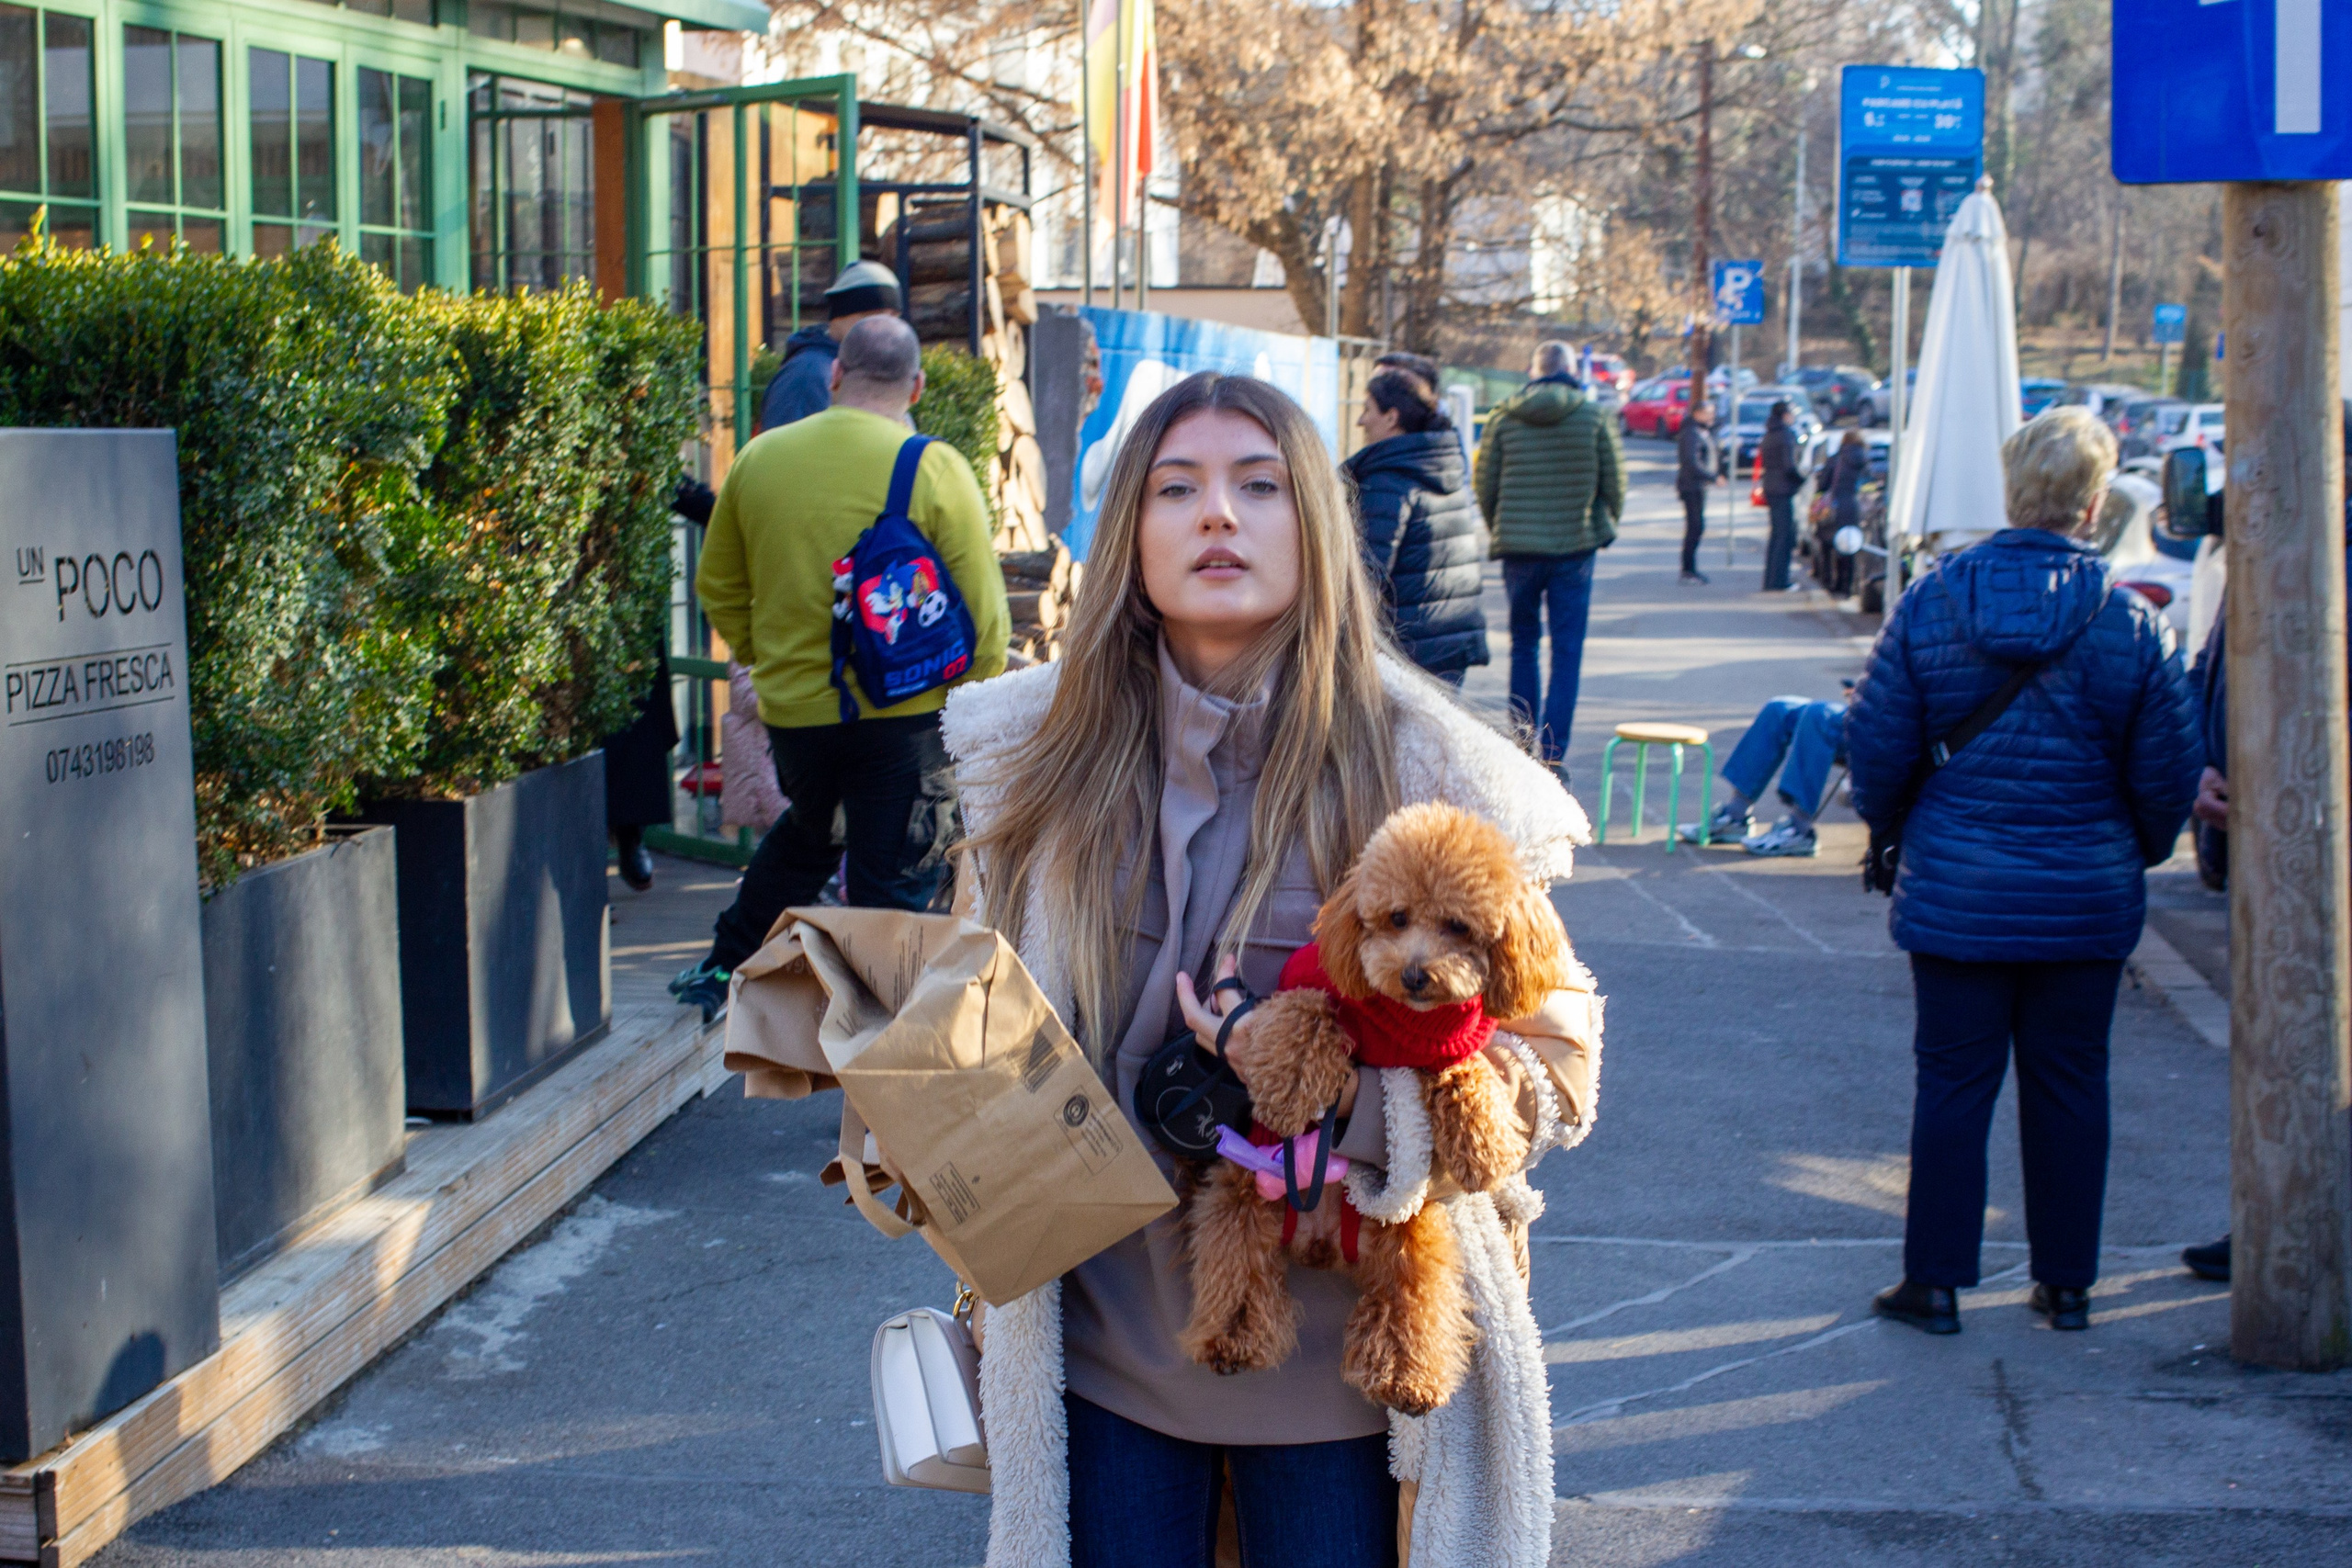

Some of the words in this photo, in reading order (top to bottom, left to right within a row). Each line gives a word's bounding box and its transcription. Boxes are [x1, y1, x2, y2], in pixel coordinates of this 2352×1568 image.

[17, 547, 44, 577] UN
[54, 549, 163, 623] POCO
[6, 665, 79, 714] PIZZA
[85, 651, 175, 701] FRESCA
[885, 638, 965, 687] SONIC
[47, 732, 154, 784] 0743198198
